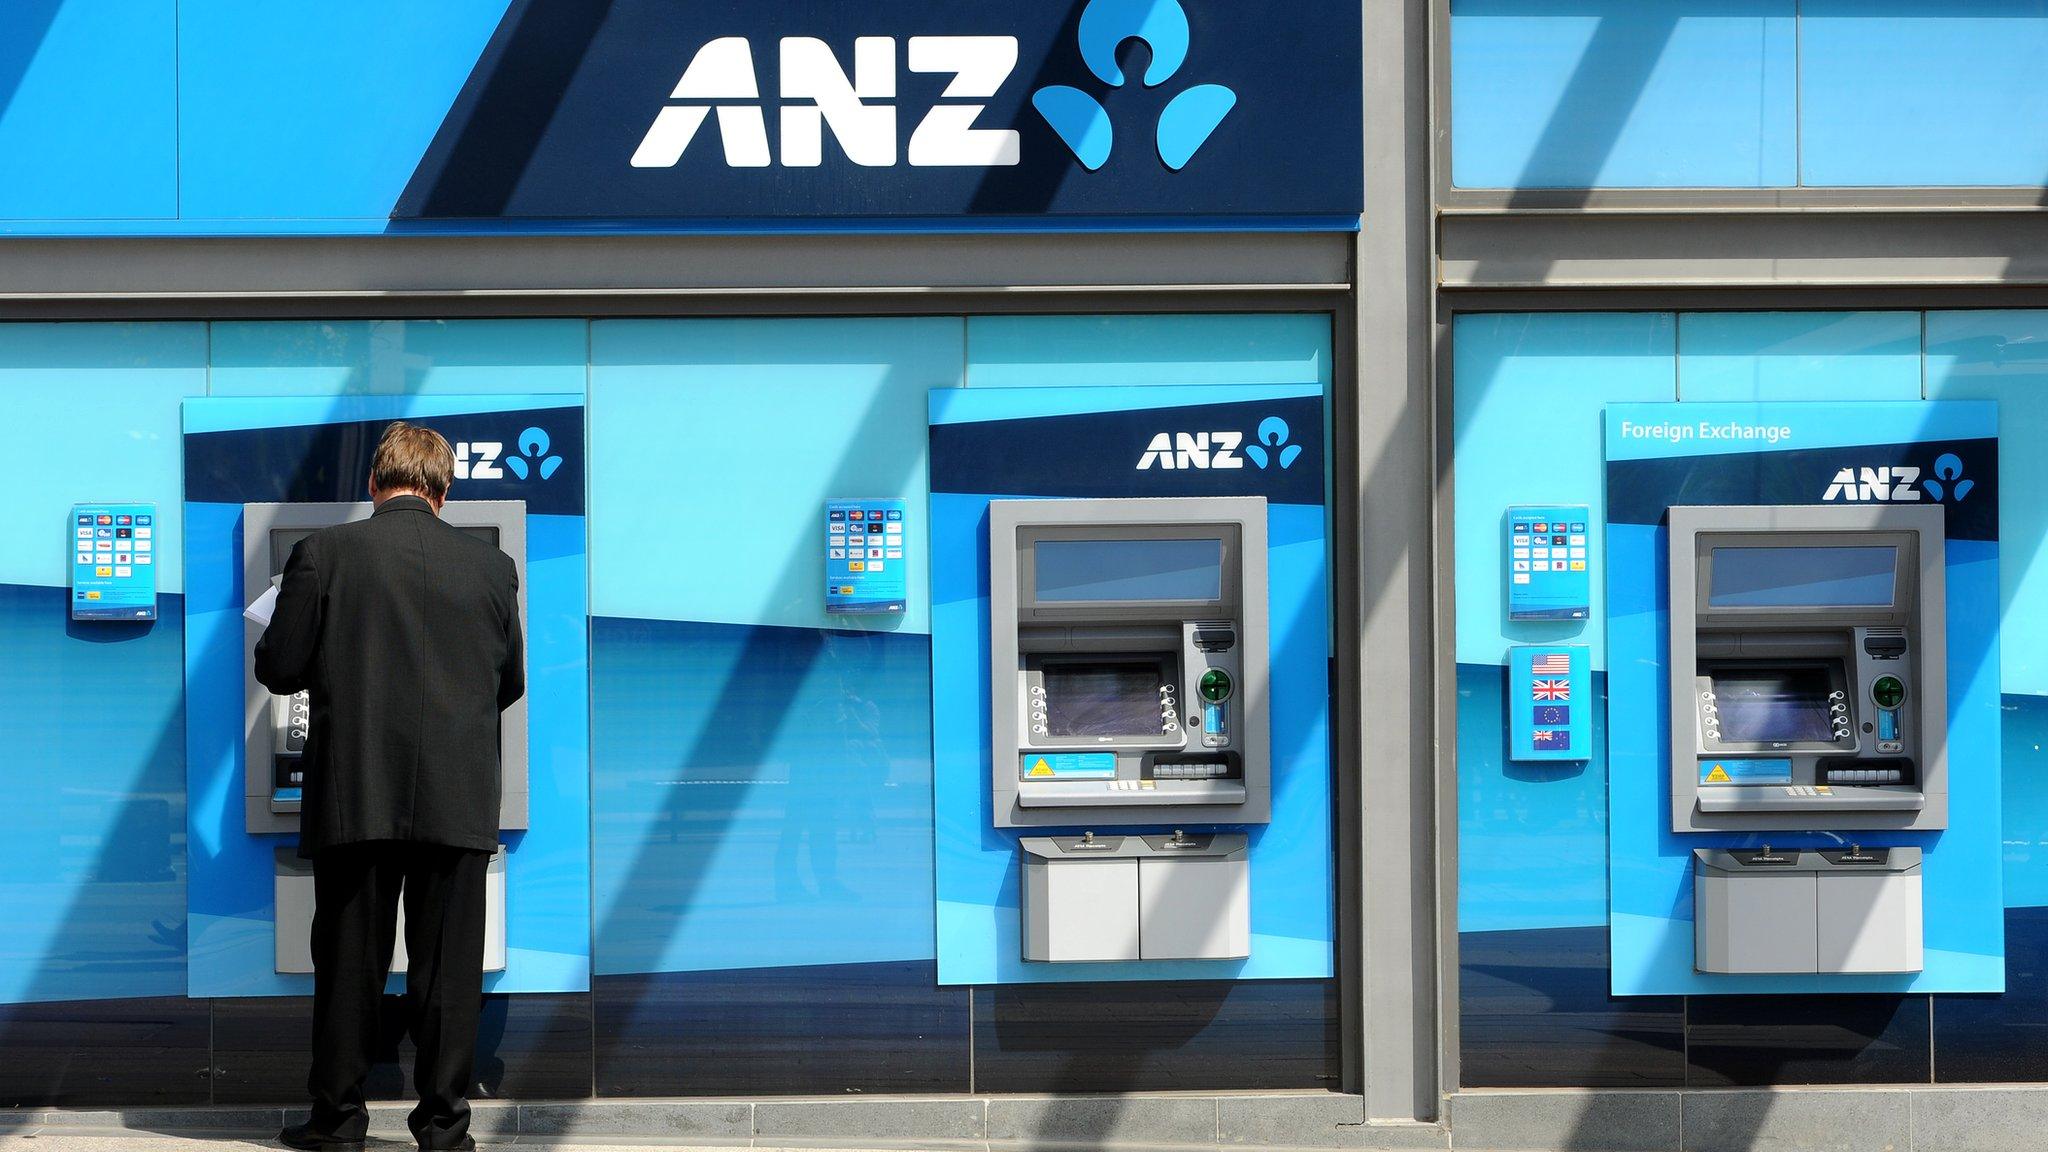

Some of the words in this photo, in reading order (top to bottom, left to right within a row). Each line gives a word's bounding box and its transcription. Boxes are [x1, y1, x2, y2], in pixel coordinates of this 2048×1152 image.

[629, 35, 1021, 167] ANZ
[1136, 431, 1244, 469] ANZ
[1621, 421, 1693, 443] Foreign
[1699, 421, 1791, 443] Exchange
[1822, 466, 1921, 501] ANZ
